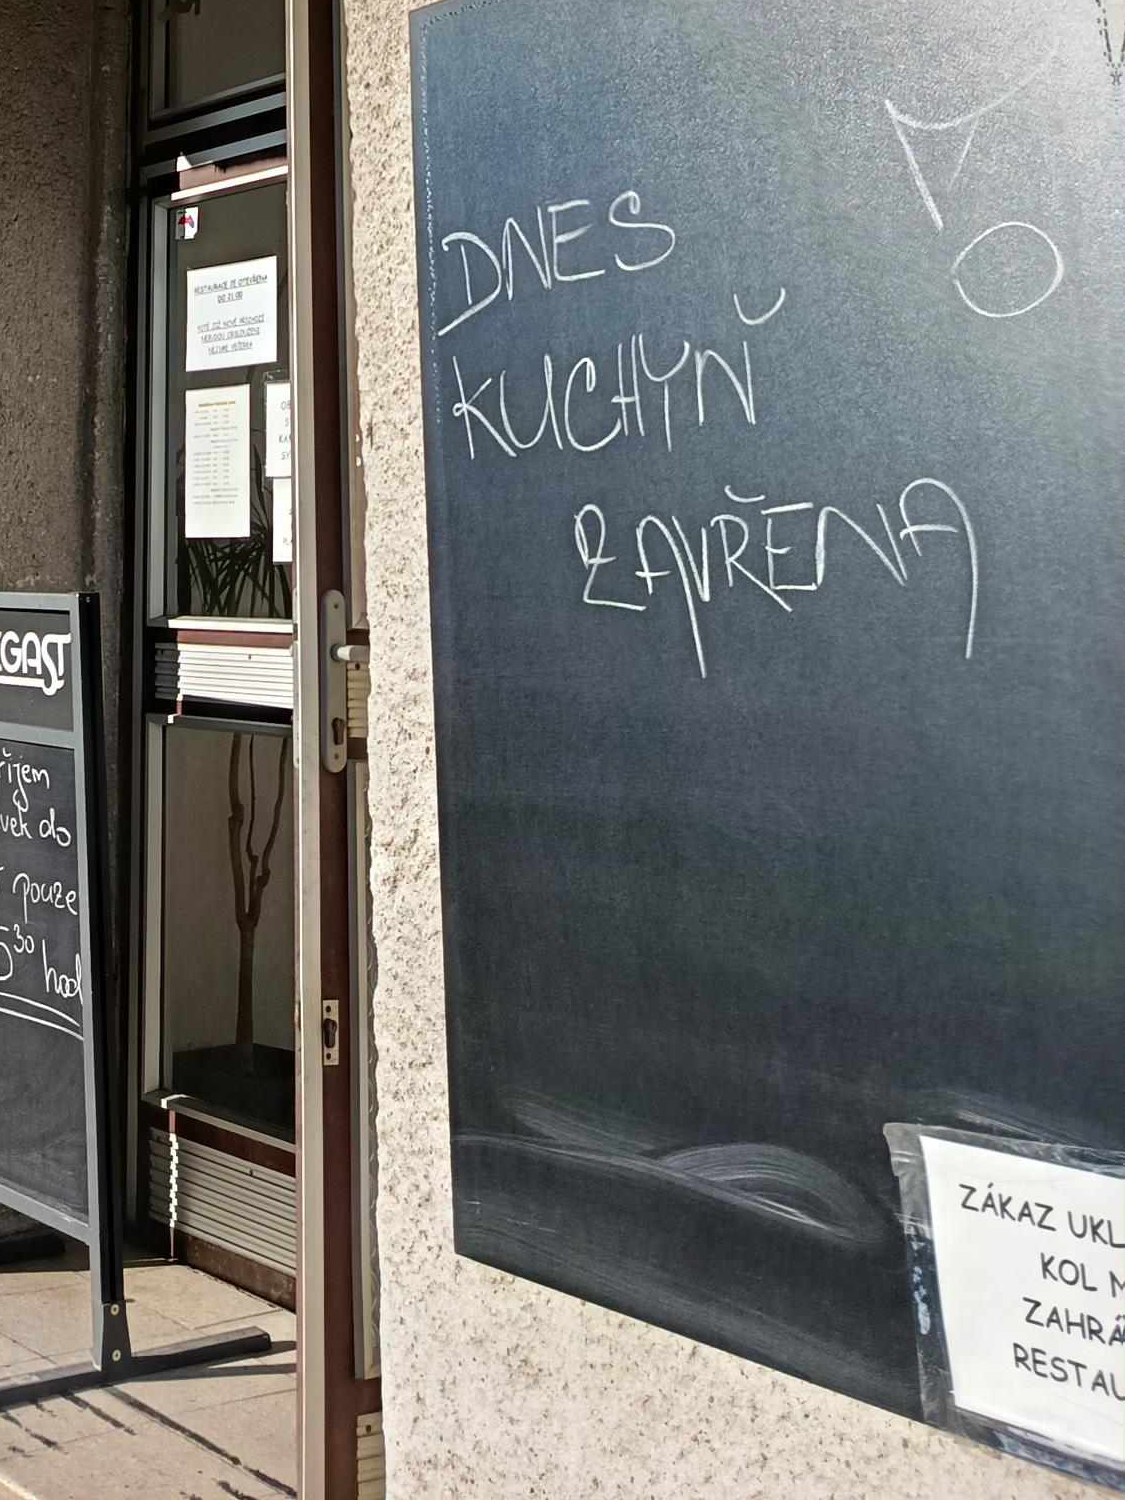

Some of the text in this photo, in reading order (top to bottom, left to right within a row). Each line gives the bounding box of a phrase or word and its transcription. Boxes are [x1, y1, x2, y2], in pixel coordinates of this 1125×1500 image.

[438, 190, 675, 336] DNES
[452, 287, 785, 460] KUCHYŇ
[573, 477, 978, 679] ZAVŘENA
[39, 807, 72, 847] do
[12, 872, 79, 924] pouze
[42, 938, 84, 1005] hod
[958, 1182, 1057, 1232] ZÁKAZ
[1039, 1252, 1098, 1292] KOL
